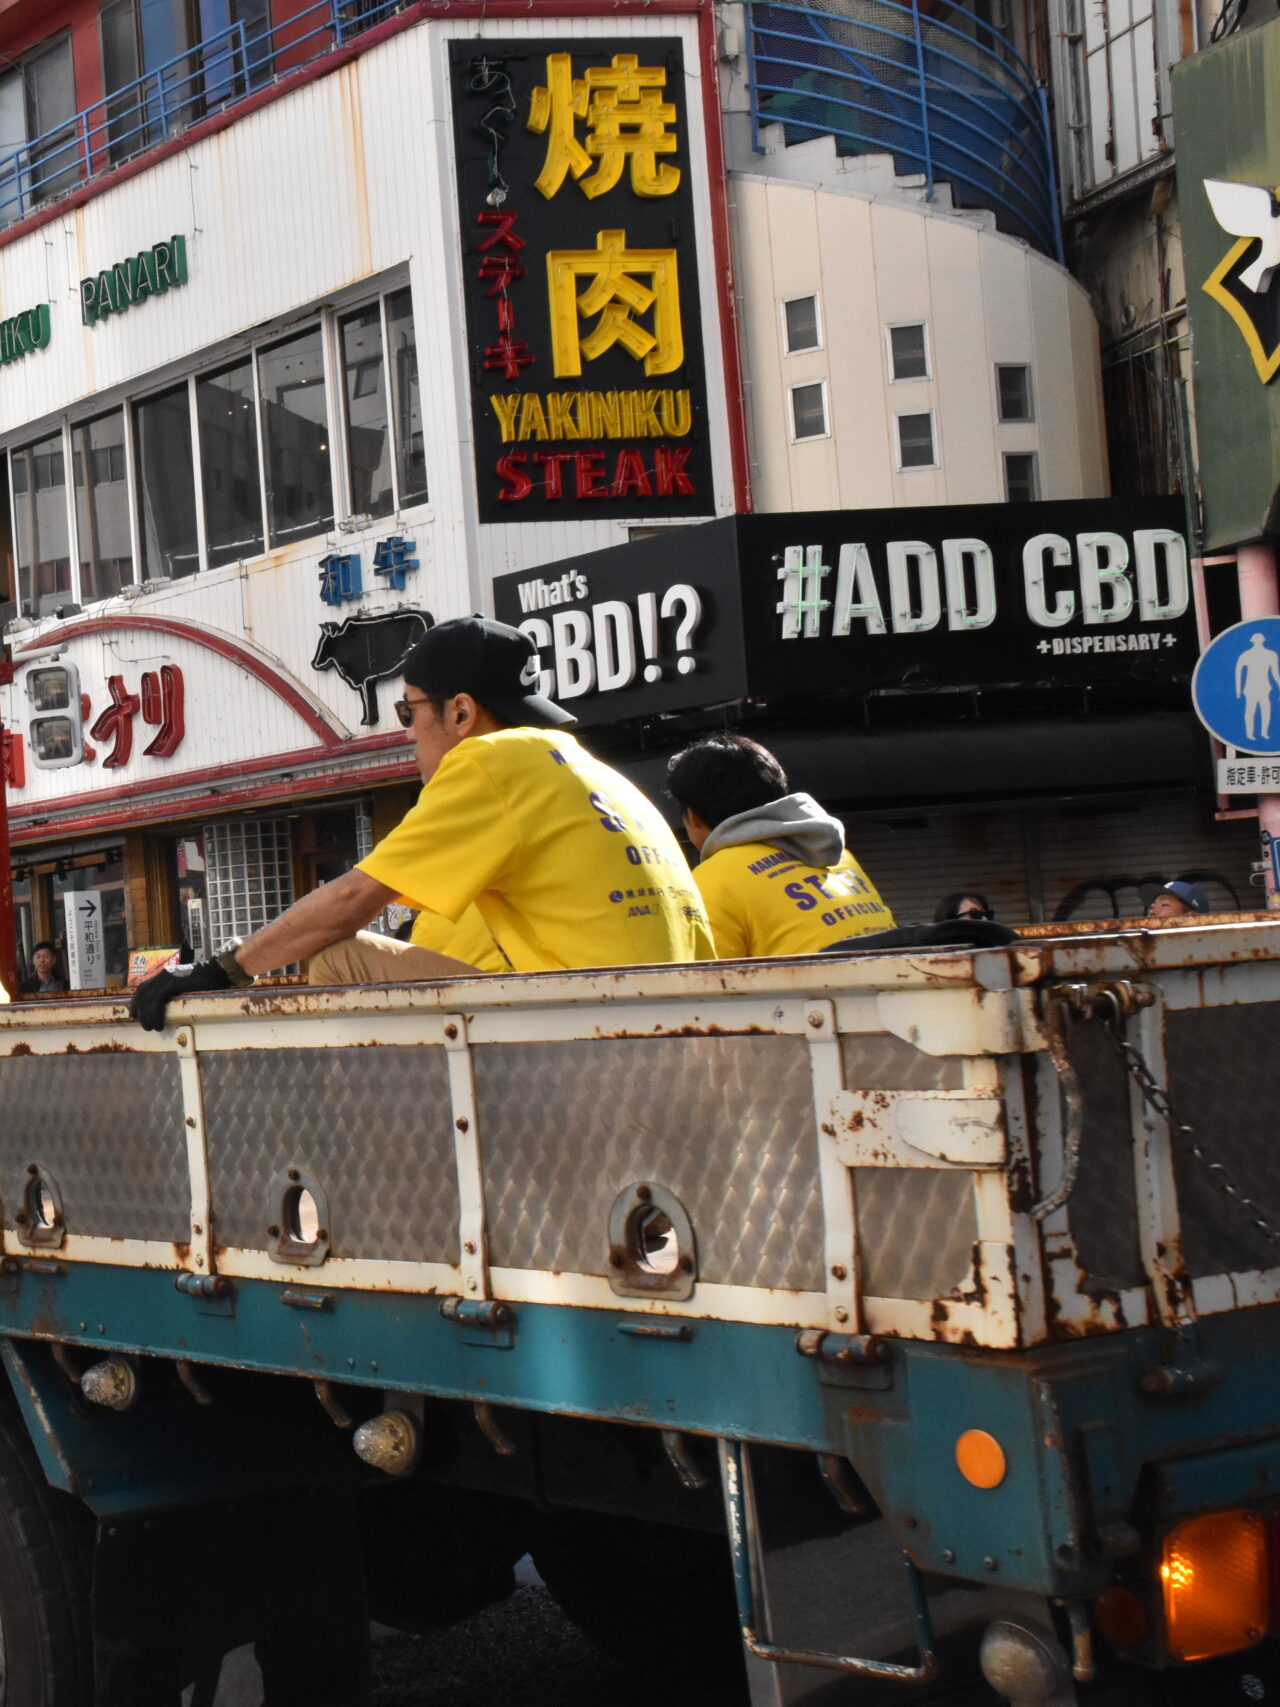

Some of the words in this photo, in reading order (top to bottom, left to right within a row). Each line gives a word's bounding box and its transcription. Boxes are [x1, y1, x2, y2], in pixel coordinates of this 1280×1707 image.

[525, 53, 684, 379] 焼肉
[80, 234, 188, 327] PANARI
[490, 389, 692, 443] YAKINIKU
[496, 447, 697, 501] STEAK
[318, 536, 419, 606] 和牛
[518, 569, 589, 613] What's
[776, 538, 998, 640] #ADD
[1022, 528, 1190, 628] CBD
[81, 663, 185, 768] ナリ
[84, 920, 95, 966] 平和通り
